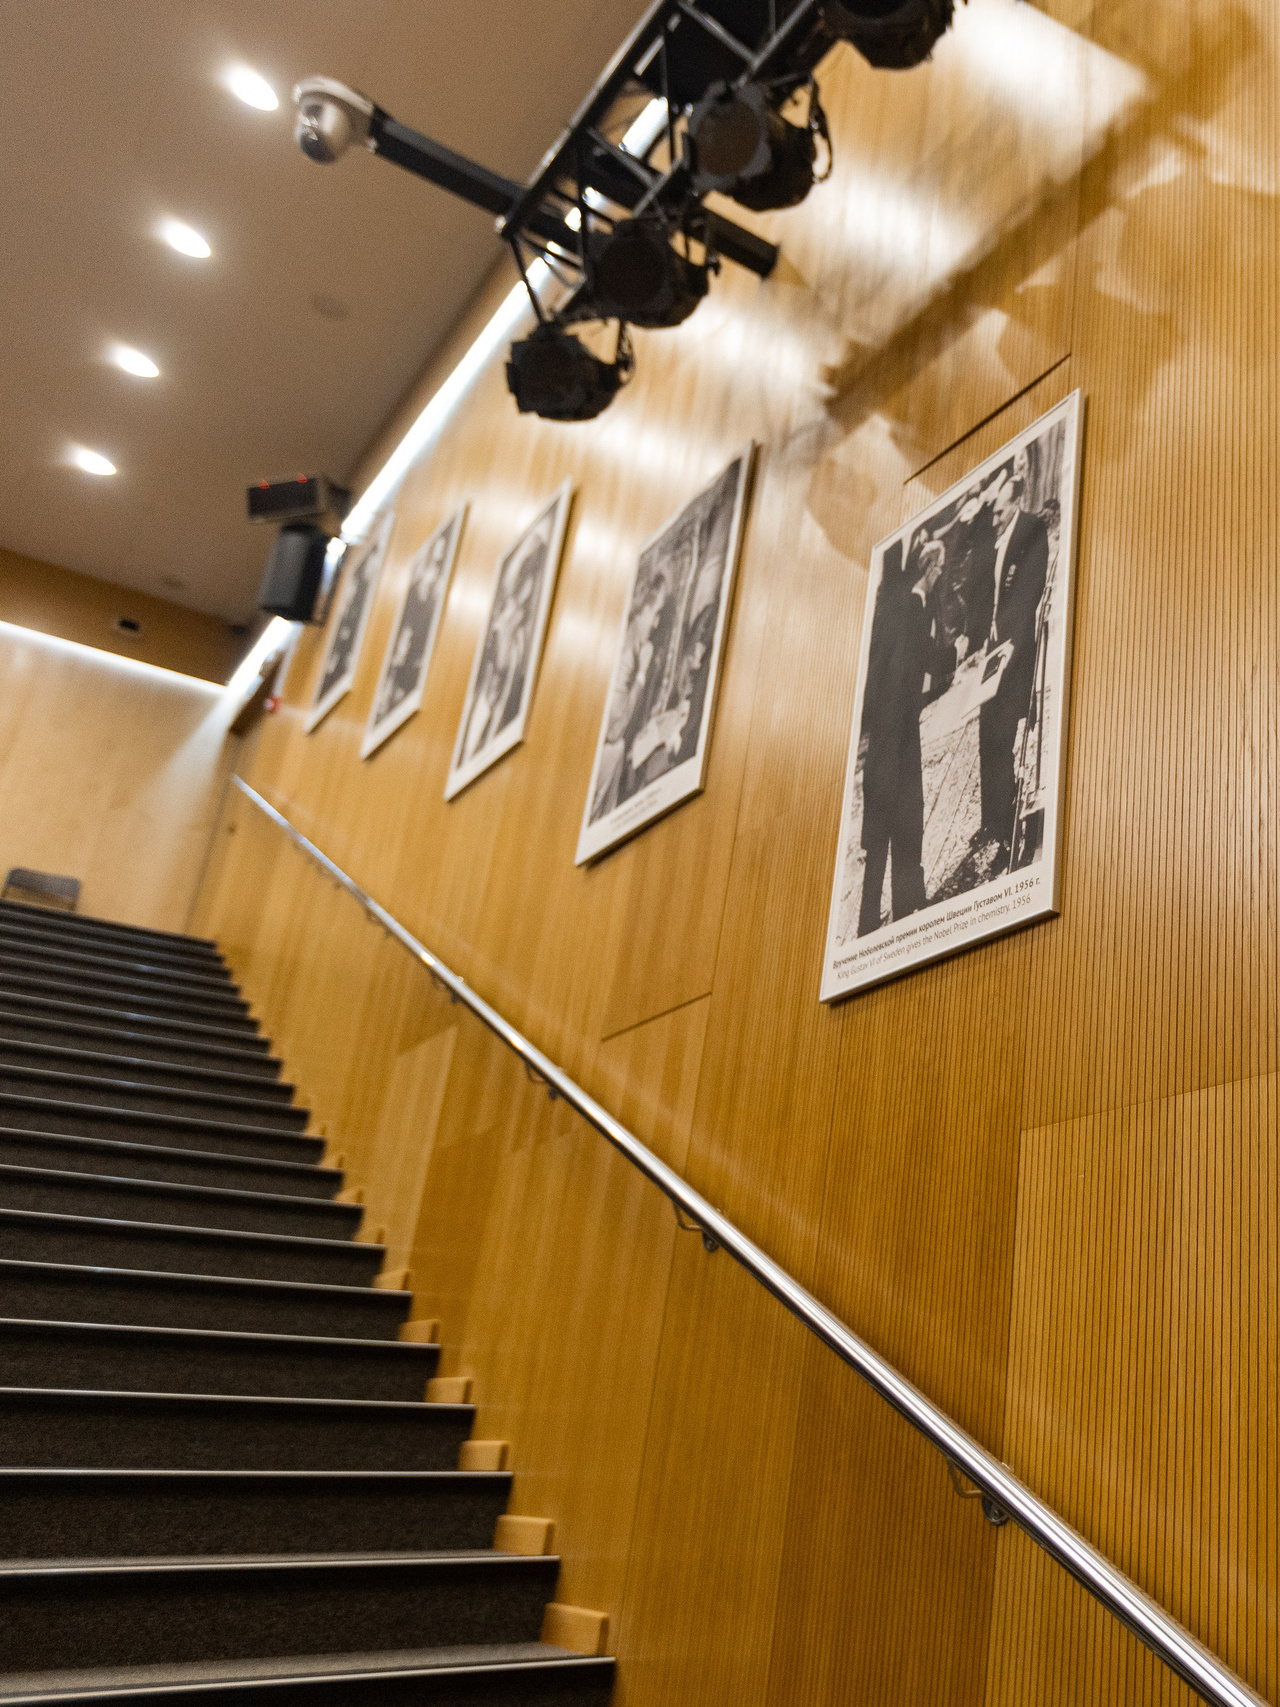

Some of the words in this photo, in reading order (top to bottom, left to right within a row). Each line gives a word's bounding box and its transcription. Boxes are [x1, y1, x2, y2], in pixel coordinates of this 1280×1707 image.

[850, 963, 868, 975] Gustav
[869, 957, 876, 967] VI
[876, 953, 883, 964] of
[883, 946, 906, 962] Sweden
[906, 939, 922, 954] gives
[922, 934, 933, 946] the
[934, 925, 952, 940] Nobel
[953, 920, 969, 933] Prize
[969, 916, 977, 926] in
[1012, 893, 1031, 909] 1956
[858, 936, 895, 958] Нобелевской
[896, 928, 918, 944] премии
[946, 906, 972, 921] Швеции
[973, 893, 1003, 912] Густавом
[1014, 878, 1034, 893] 1956
[1035, 877, 1041, 885] г.
